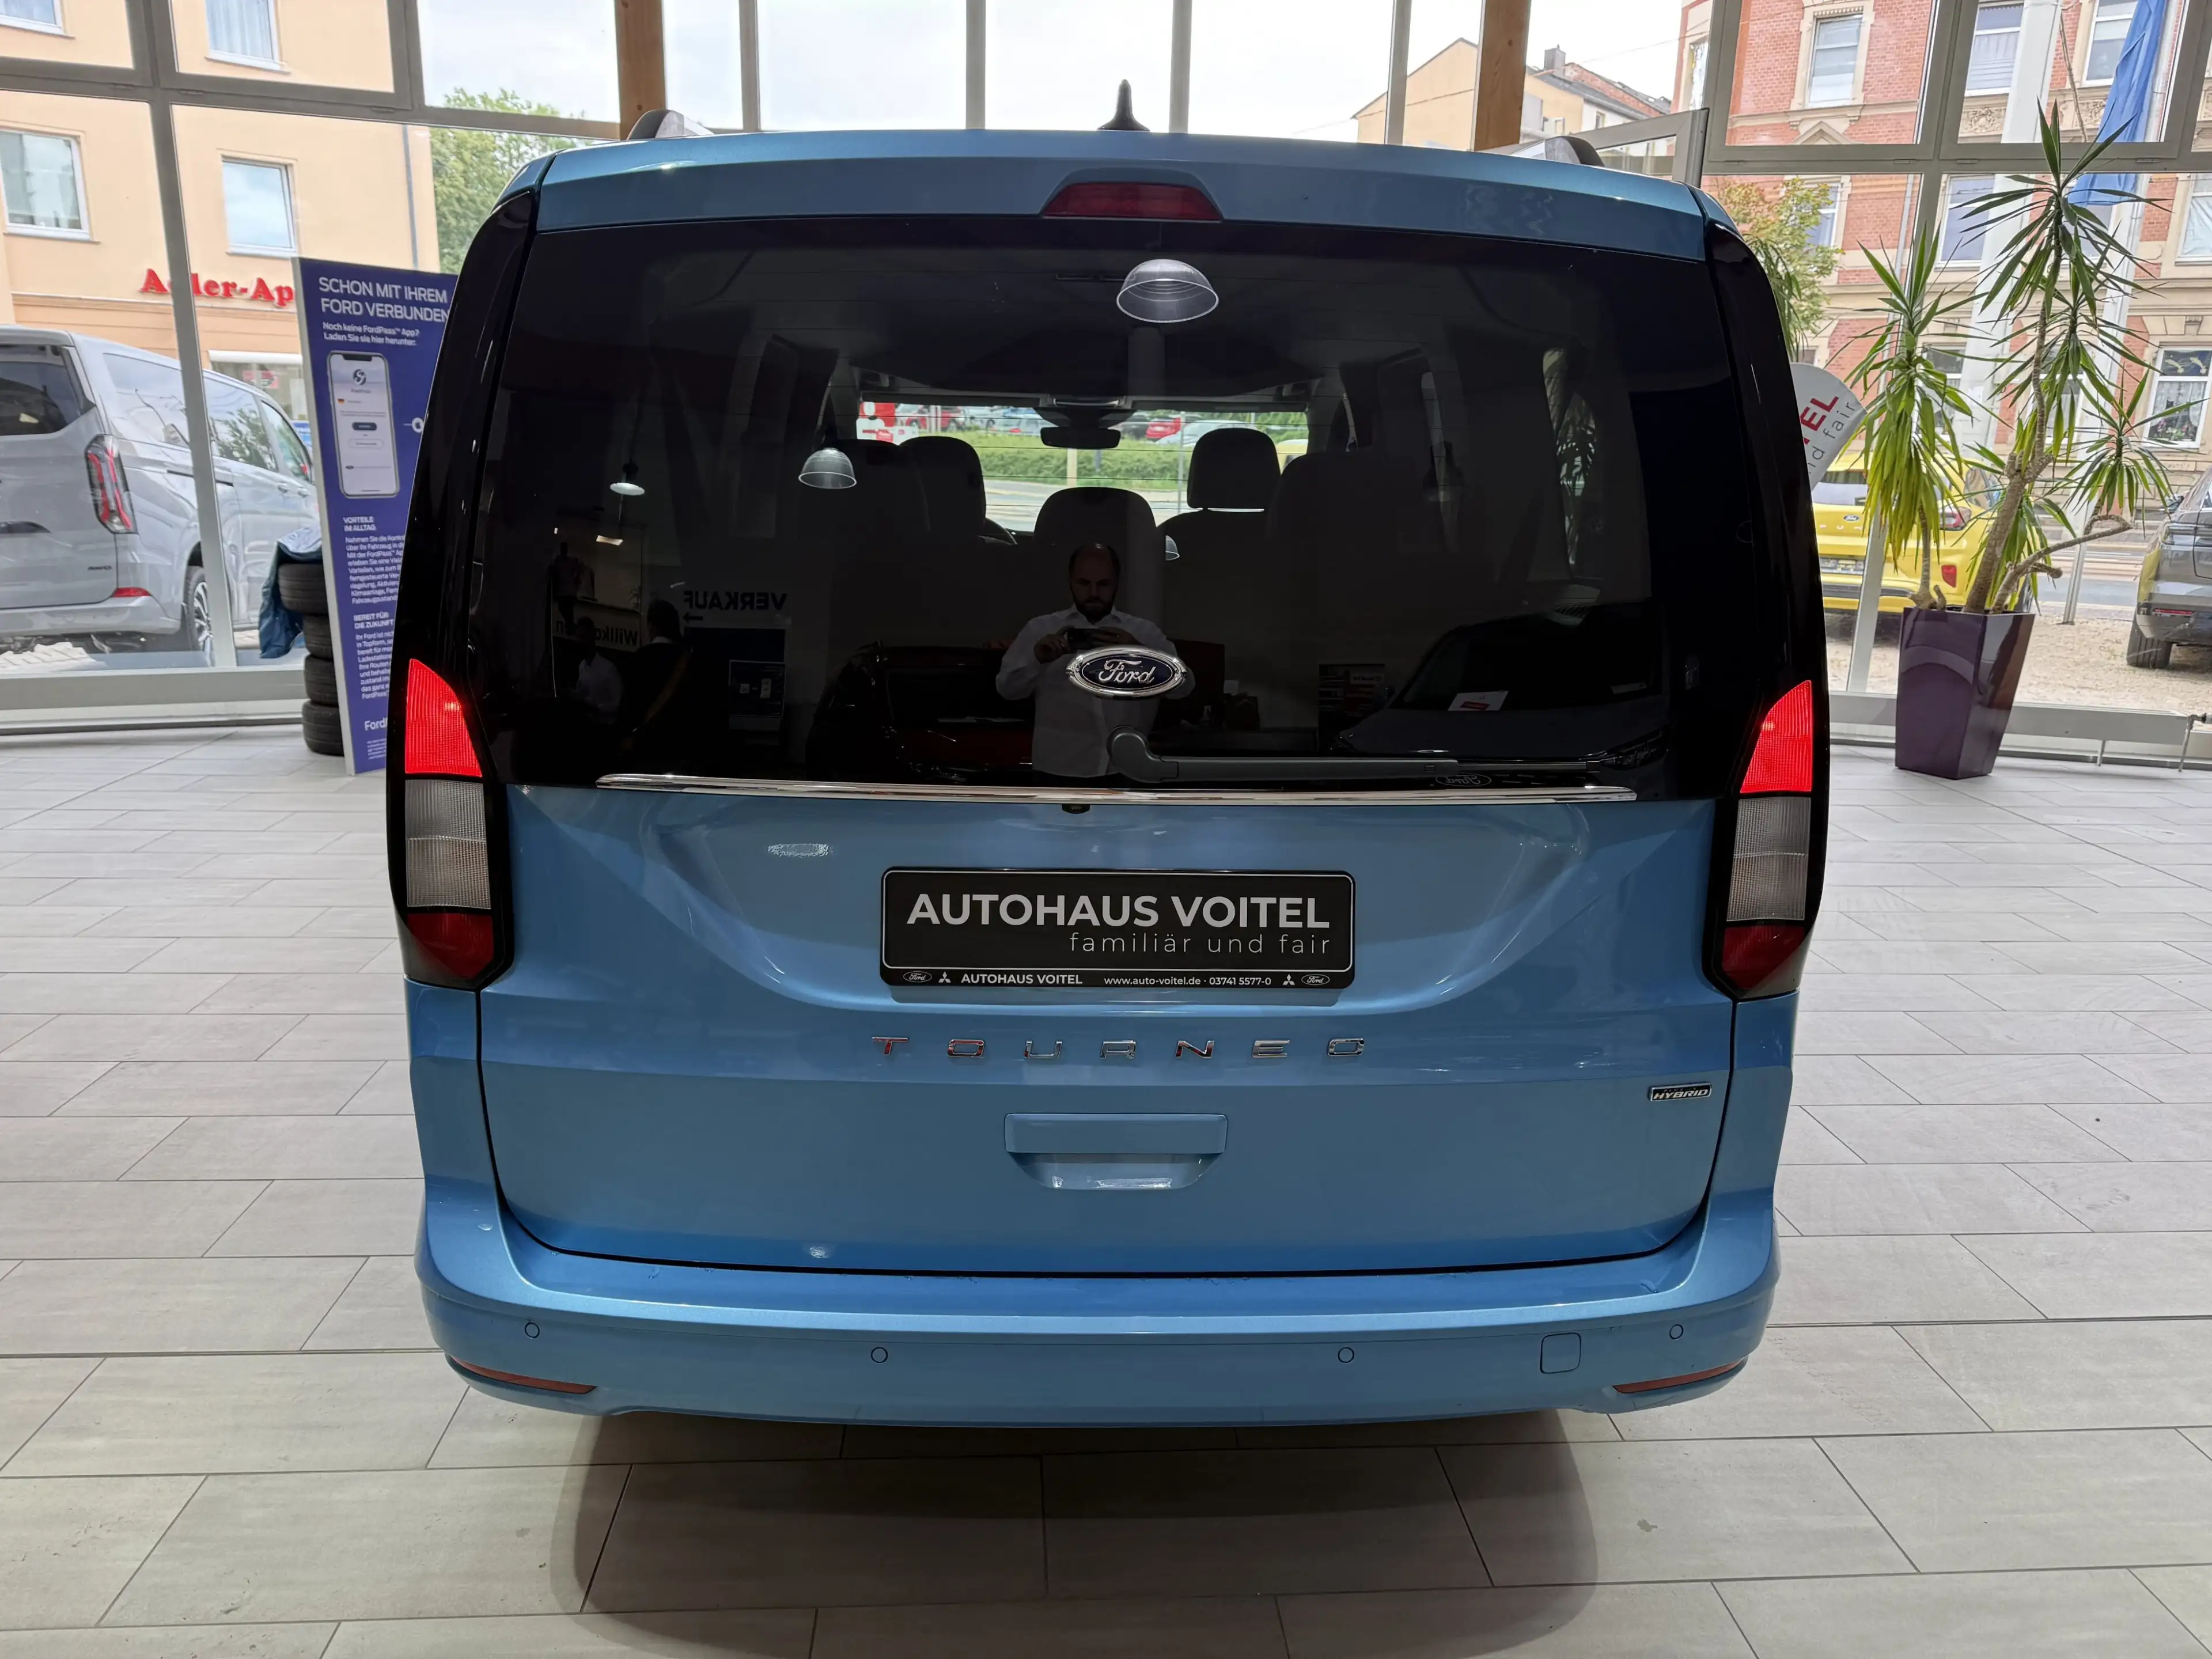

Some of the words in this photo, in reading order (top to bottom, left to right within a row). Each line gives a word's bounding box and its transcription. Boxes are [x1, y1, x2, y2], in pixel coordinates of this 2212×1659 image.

[139, 268, 294, 307] Aler-Ap
[319, 276, 374, 297] SCHON
[376, 283, 402, 299] MIT
[404, 286, 448, 303] IHREM
[321, 298, 363, 316] FORD
[365, 302, 449, 322] VERBUNDEN
[323, 321, 342, 331] Noch
[343, 324, 363, 333] keine
[323, 332, 347, 342] Laden
[347, 334, 359, 343] Sie
[360, 335, 370, 343] sie
[1800, 396, 1839, 445] EL
[1823, 402, 1855, 439] fair
[1097, 658, 1157, 684] Ford
[906, 892, 1159, 927] AUTOHAUS
[1171, 896, 1330, 929] VOITEL
[1070, 931, 1191, 953] familiär
[1207, 932, 1264, 954] und
[1279, 932, 1331, 955] fair
[908, 972, 927, 981] Ford
[960, 974, 1034, 984] AUTOHAUS
[1037, 974, 1083, 985] VOITEL
[1104, 976, 1202, 985] www.auto-voitel.de
[1209, 977, 1237, 986] 03741
[1238, 977, 1271, 986] 5577-0
[1306, 975, 1325, 984] Ford
[872, 1036, 1366, 1060] TOURNEO
[1653, 1089, 1709, 1100] HYBRID
